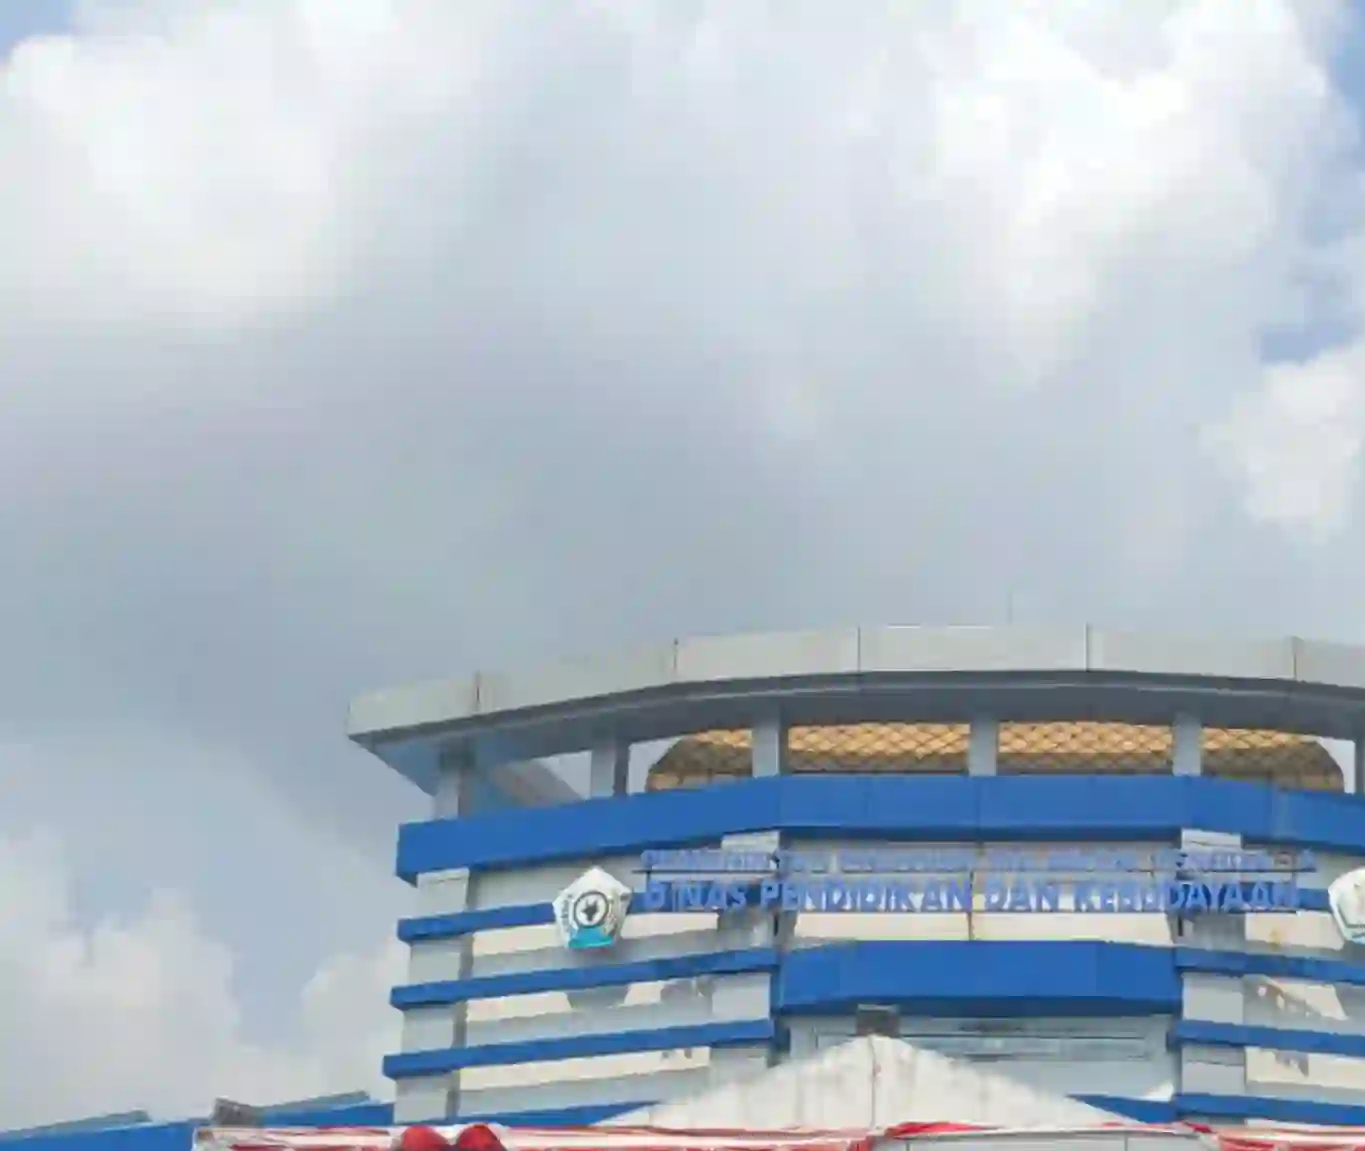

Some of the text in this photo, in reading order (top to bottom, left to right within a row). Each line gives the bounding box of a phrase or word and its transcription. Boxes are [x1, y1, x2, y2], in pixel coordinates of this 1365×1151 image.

[644, 877, 1298, 913] DINAS PENDIDIKAN DAN KEBUDAYAAN
